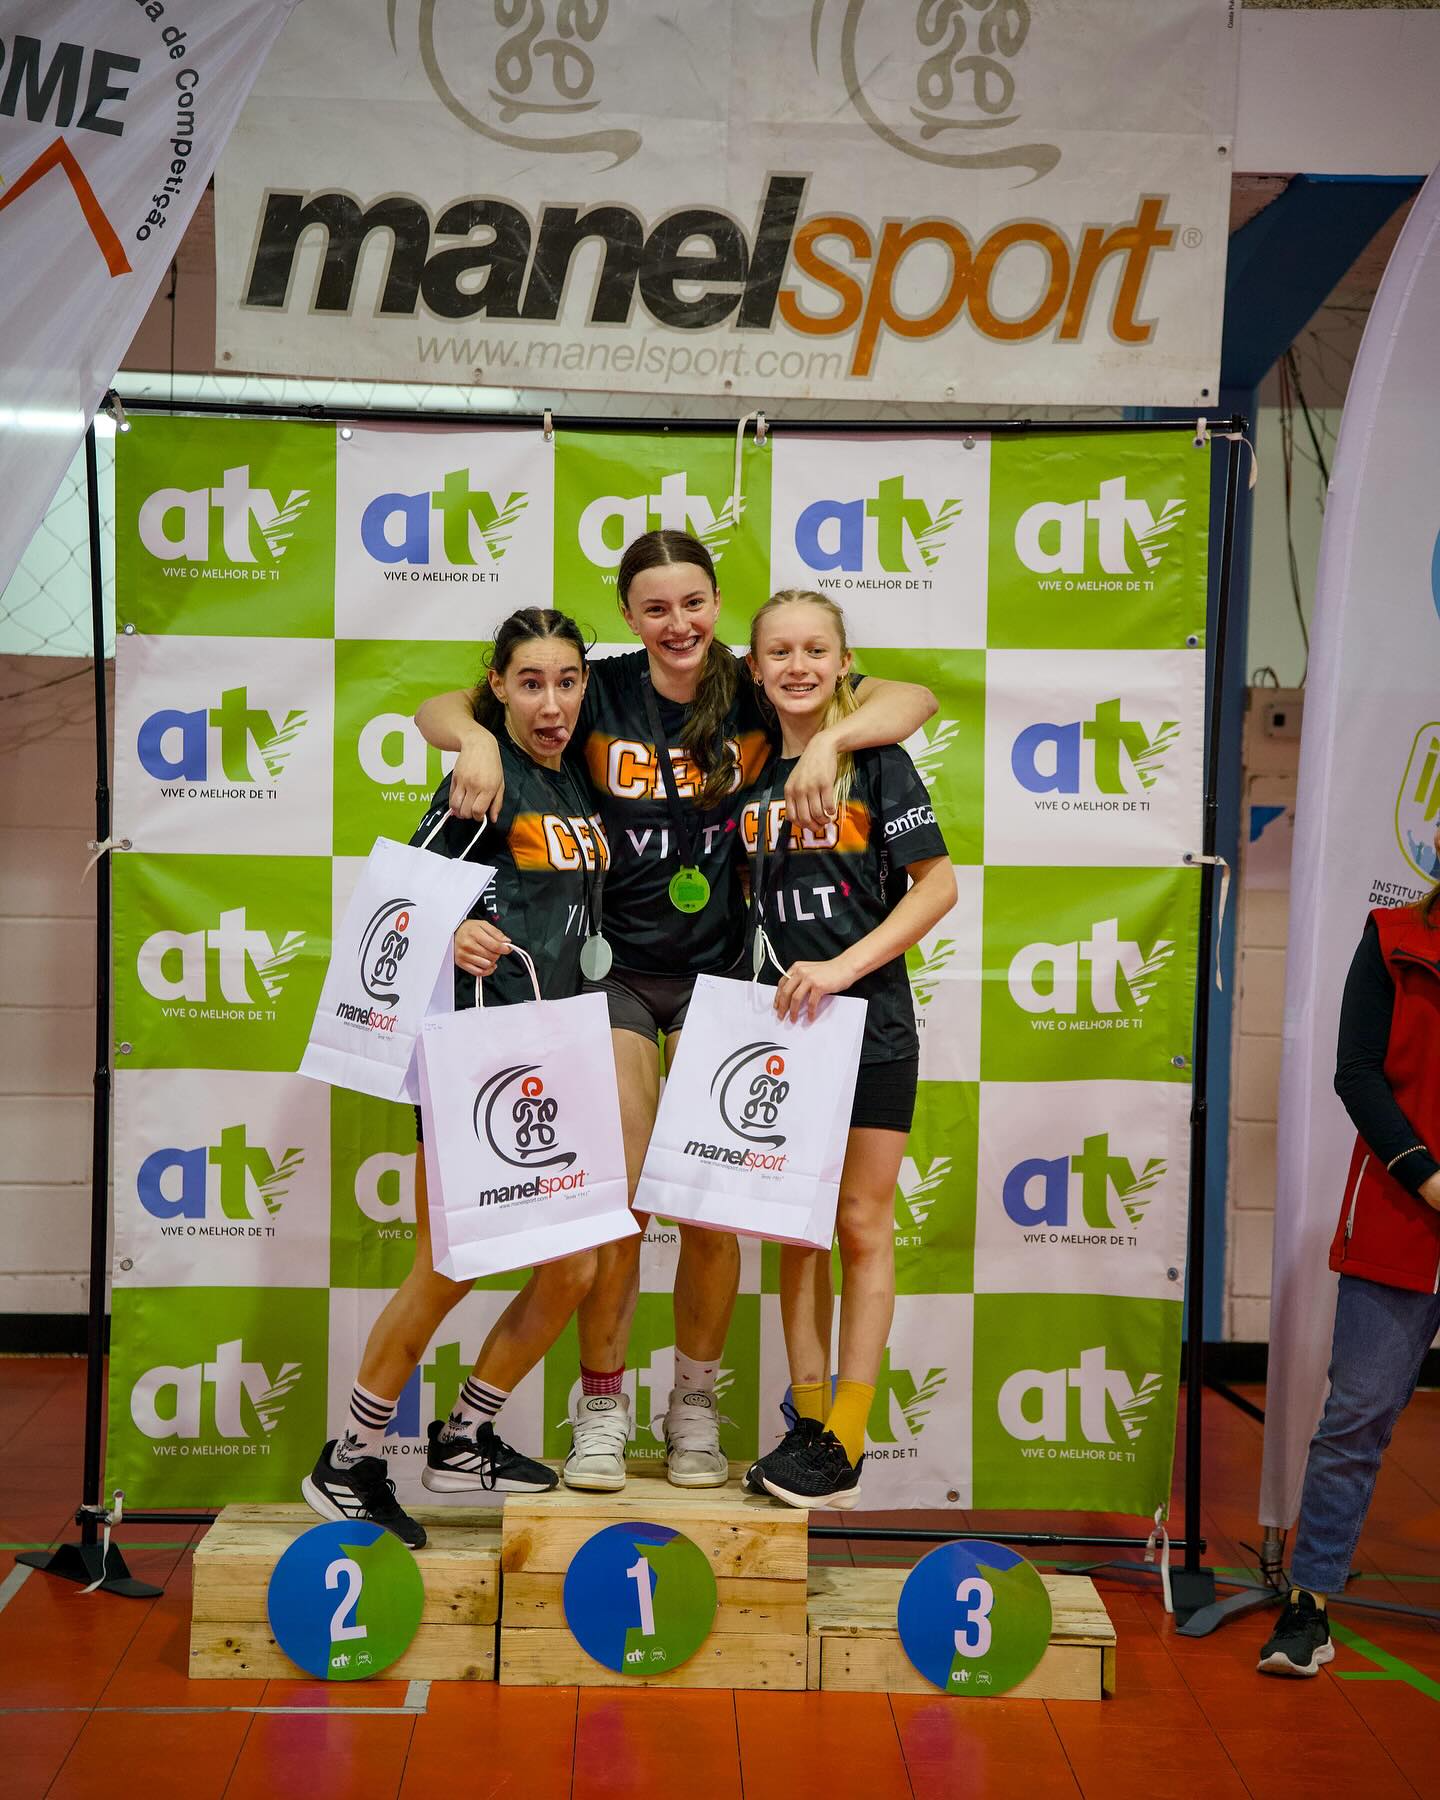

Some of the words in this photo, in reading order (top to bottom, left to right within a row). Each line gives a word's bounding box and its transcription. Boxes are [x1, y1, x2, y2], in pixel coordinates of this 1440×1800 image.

[162, 26, 187, 60] de
[0, 35, 141, 137] ME
[136, 68, 200, 241] Competição
[241, 172, 1174, 381] manelsport
[417, 336, 843, 383] www.manelsport.com
[139, 465, 310, 563] atv
[361, 469, 529, 565] atv
[795, 475, 964, 572] atv
[1014, 476, 1187, 574] atv
[162, 568, 186, 577] VIVE
[189, 568, 198, 577] O
[202, 569, 246, 579] MELHOR
[251, 570, 264, 579] DE
[268, 570, 279, 580] TI
[384, 572, 407, 581] VIVE
[410, 572, 419, 581] O
[423, 573, 468, 582] MELHOR
[472, 573, 485, 582] DE
[488, 573, 499, 582] TI
[817, 579, 841, 588] VIVE
[844, 579, 853, 588] O
[857, 580, 902, 589] MELHOR
[906, 580, 919, 589] DE
[922, 581, 932, 590] TI
[1038, 581, 1062, 590] VIVE
[1065, 581, 1074, 590] O
[1077, 581, 1122, 591] MELHOR
[1126, 581, 1140, 591] DE
[1143, 581, 1154, 590] TI
[137, 686, 307, 782] atv
[1011, 698, 1182, 794] atv
[161, 788, 184, 798] VIVE
[188, 788, 197, 798] O
[200, 789, 246, 798] MELHOR
[250, 789, 263, 799] DE
[266, 790, 277, 799] TI
[382, 792, 405, 801] VIVE
[408, 792, 417, 801] O
[1034, 801, 1058, 810] VIVE
[1061, 801, 1070, 810] O
[1073, 801, 1118, 811] MELHOR
[1122, 802, 1136, 811] DE
[1139, 802, 1150, 811] TI
[884, 806, 937, 838] onfiCo
[625, 824, 720, 859] VIT
[1372, 879, 1424, 902] INSTITUT
[136, 906, 306, 1004] atv
[1007, 917, 1176, 1014] atv
[162, 1007, 185, 1017] VIVE
[188, 1008, 198, 1017] O
[200, 1009, 243, 1019] MELHOR
[248, 1010, 261, 1020] DE
[264, 1010, 275, 1020] TI
[335, 1002, 397, 1033] manelsport
[1031, 1020, 1055, 1030] VIVE
[1057, 1020, 1067, 1030] O
[1069, 1020, 1114, 1030] MELHOR
[1115, 1019, 1129, 1029] DE
[1132, 1018, 1143, 1028] TI
[137, 1123, 304, 1219] atv
[684, 1140, 787, 1172] manelsport
[479, 1169, 586, 1207] manelsport
[1003, 1133, 1167, 1229] atv
[160, 1226, 184, 1235] VIVE
[187, 1226, 196, 1235] O
[199, 1227, 244, 1236] MELHOR
[248, 1227, 261, 1237] DE
[264, 1228, 274, 1237] TI
[378, 1230, 401, 1239] VIVE
[404, 1230, 413, 1239] O
[642, 1233, 677, 1243] ELHOR
[895, 1237, 909, 1246] DE
[912, 1237, 922, 1246] TI
[1024, 1234, 1047, 1243] VIVE
[1049, 1234, 1058, 1243] O
[1061, 1234, 1106, 1244] MELHOR
[1110, 1236, 1124, 1245] DE
[1127, 1237, 1137, 1246] TI
[130, 1339, 302, 1438] atv
[998, 1346, 1162, 1444] atv
[153, 1446, 177, 1456] VIVE
[179, 1446, 189, 1456] O
[191, 1445, 240, 1455] MELHOR
[243, 1445, 257, 1455] DE
[259, 1445, 270, 1454] TI
[382, 1446, 398, 1455] IVE
[401, 1446, 411, 1455] O
[629, 1450, 665, 1459] MELHO
[865, 1450, 890, 1459] HOR
[892, 1449, 906, 1459] DE
[908, 1448, 918, 1457] TI
[1021, 1449, 1045, 1458] VIVE
[1047, 1449, 1057, 1458] O
[1060, 1449, 1105, 1460] MELHOR
[1109, 1451, 1122, 1461] DE
[1125, 1451, 1136, 1462] TI
[325, 1557, 367, 1642] 2
[626, 1557, 656, 1636] 1
[954, 1577, 993, 1658] 3
